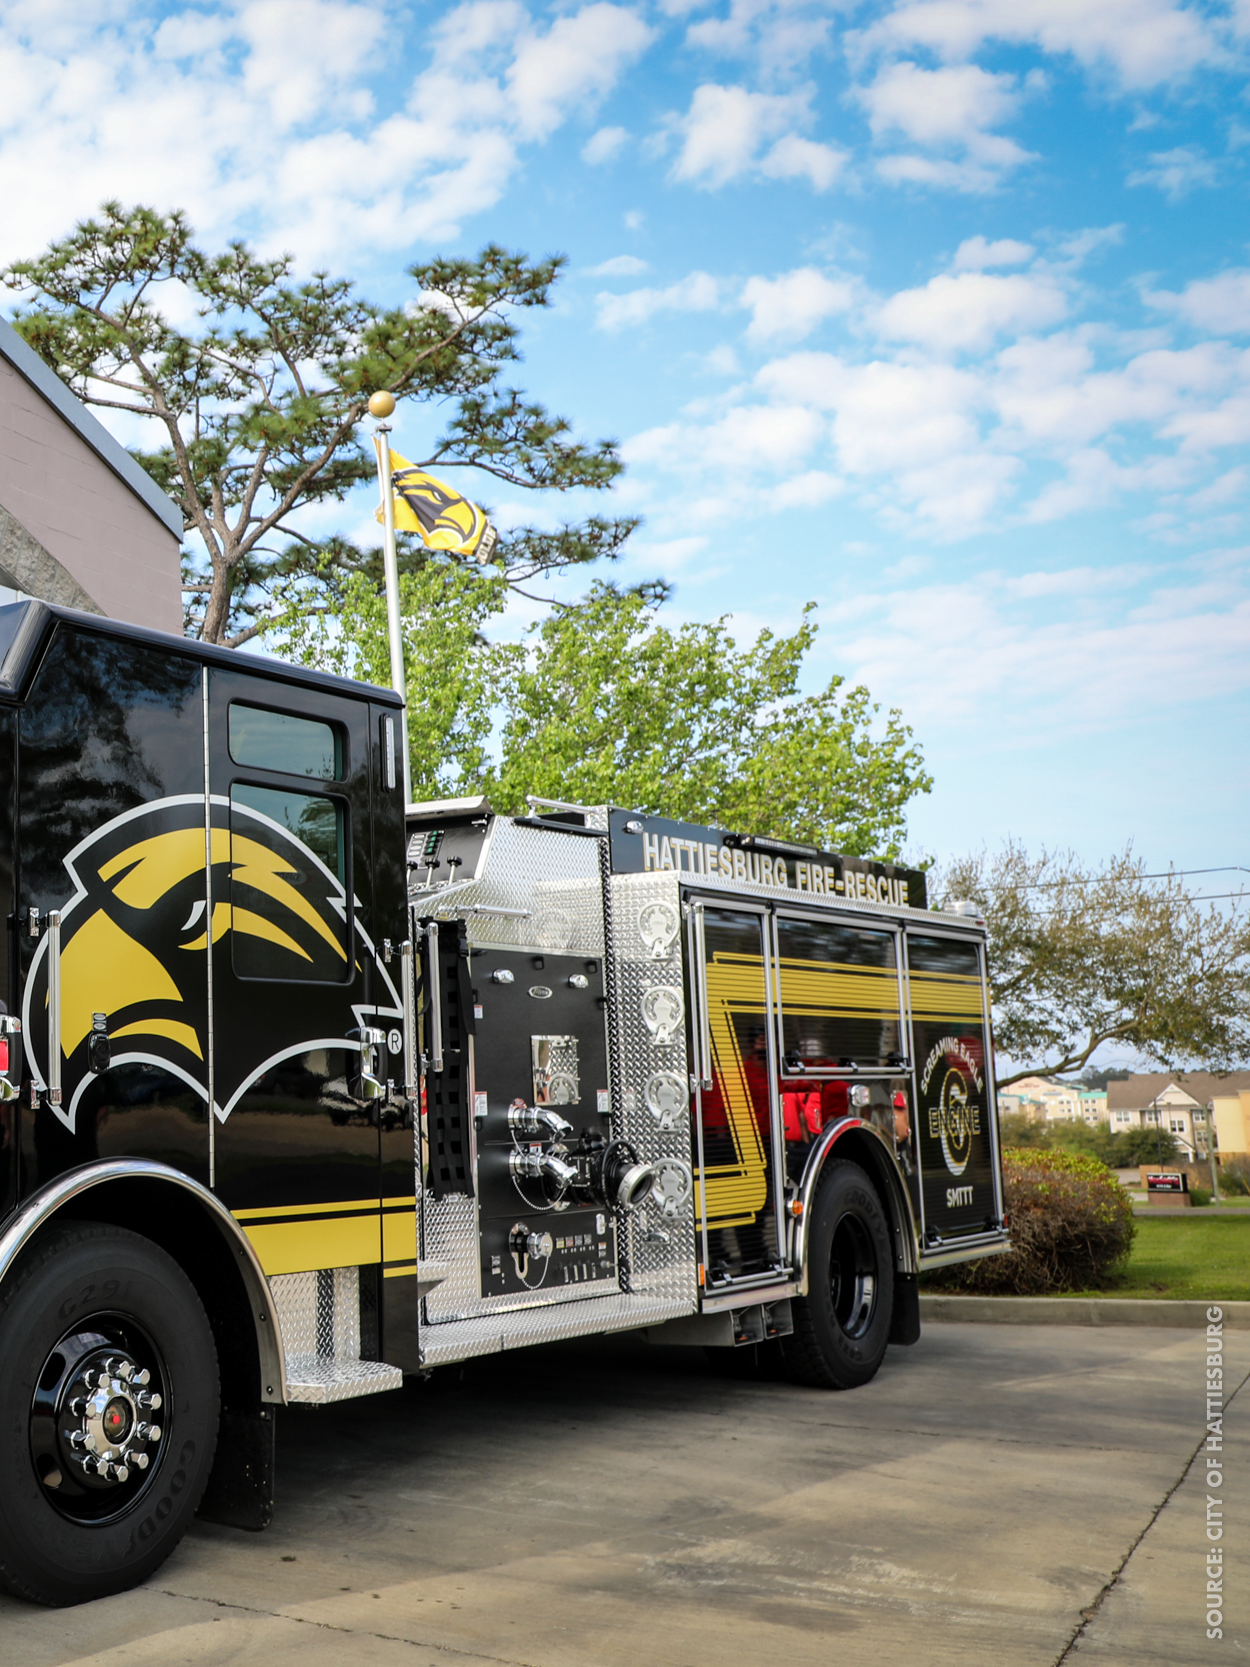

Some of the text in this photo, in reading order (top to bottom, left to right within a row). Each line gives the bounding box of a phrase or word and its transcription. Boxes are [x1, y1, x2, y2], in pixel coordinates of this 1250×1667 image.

[643, 832, 910, 908] HATTIESBURG FIRE-RESCUE
[921, 1036, 984, 1096] SCREAMING EAGLE
[928, 1105, 981, 1138] ENGINE
[946, 1186, 973, 1208] SMTTT
